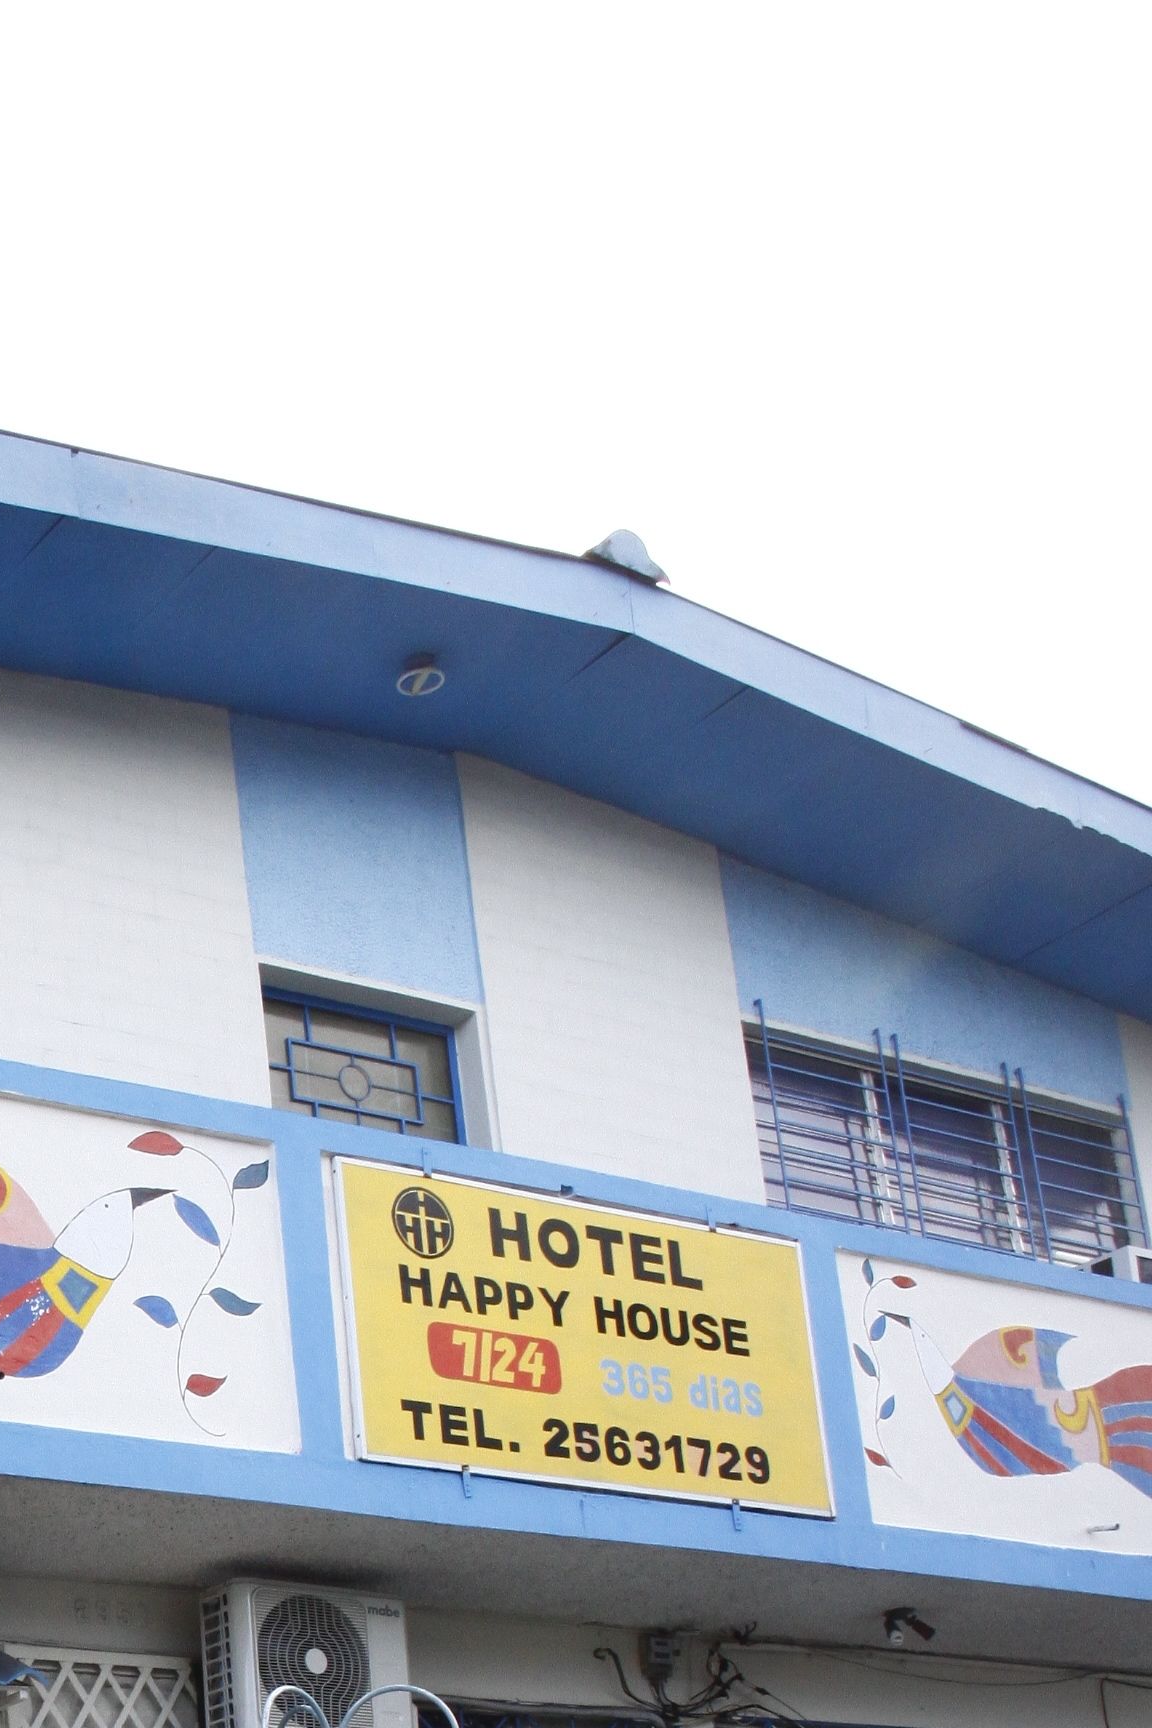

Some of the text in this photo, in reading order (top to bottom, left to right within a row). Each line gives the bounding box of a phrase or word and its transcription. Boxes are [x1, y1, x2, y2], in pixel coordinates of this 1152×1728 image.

[488, 1207, 703, 1290] HOTEL
[398, 1264, 750, 1357] HAPPY HOUSE
[600, 1359, 673, 1402] 365
[400, 1399, 770, 1485] TEL. 25631729
[367, 1604, 400, 1618] mabe
